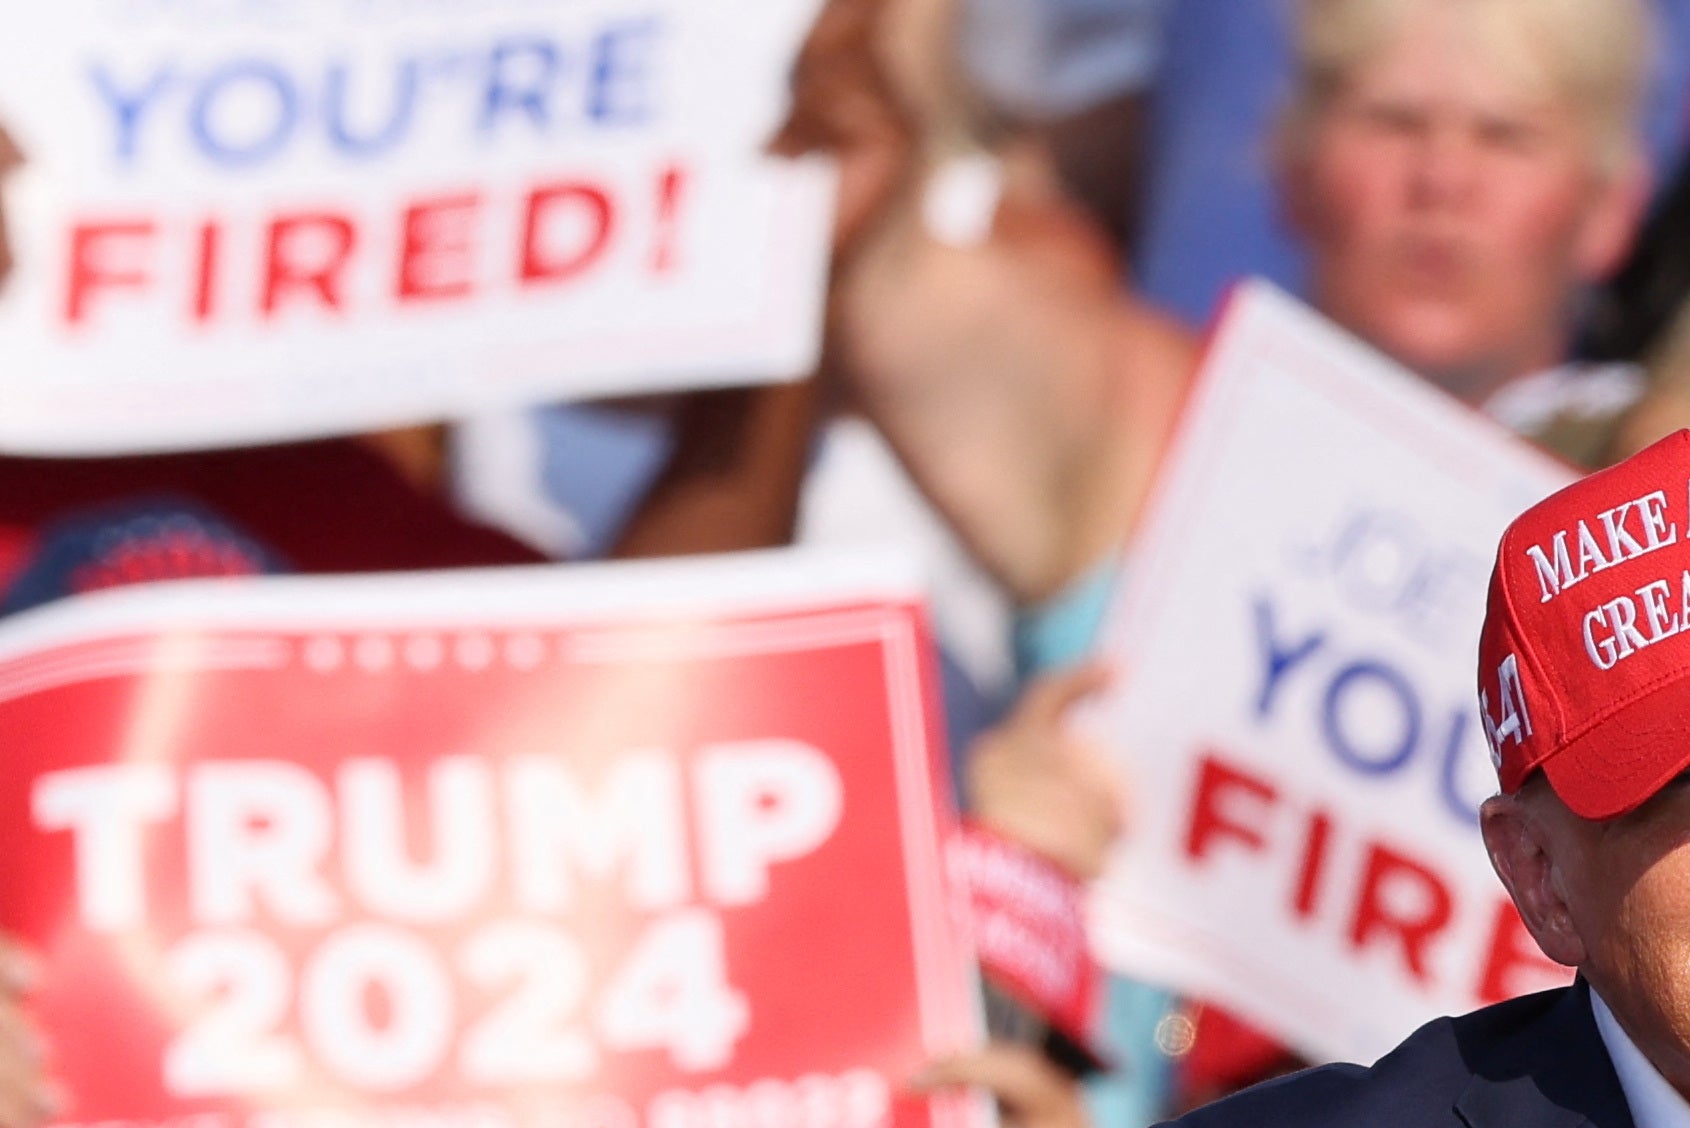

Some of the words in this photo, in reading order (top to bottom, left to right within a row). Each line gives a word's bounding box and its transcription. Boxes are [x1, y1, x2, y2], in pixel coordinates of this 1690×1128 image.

[85, 20, 662, 168] YOU'RE
[60, 166, 688, 326] FIRED!
[1525, 490, 1678, 603] MAKE
[32, 738, 845, 932] TRUMP
[164, 912, 746, 1096] 2024
